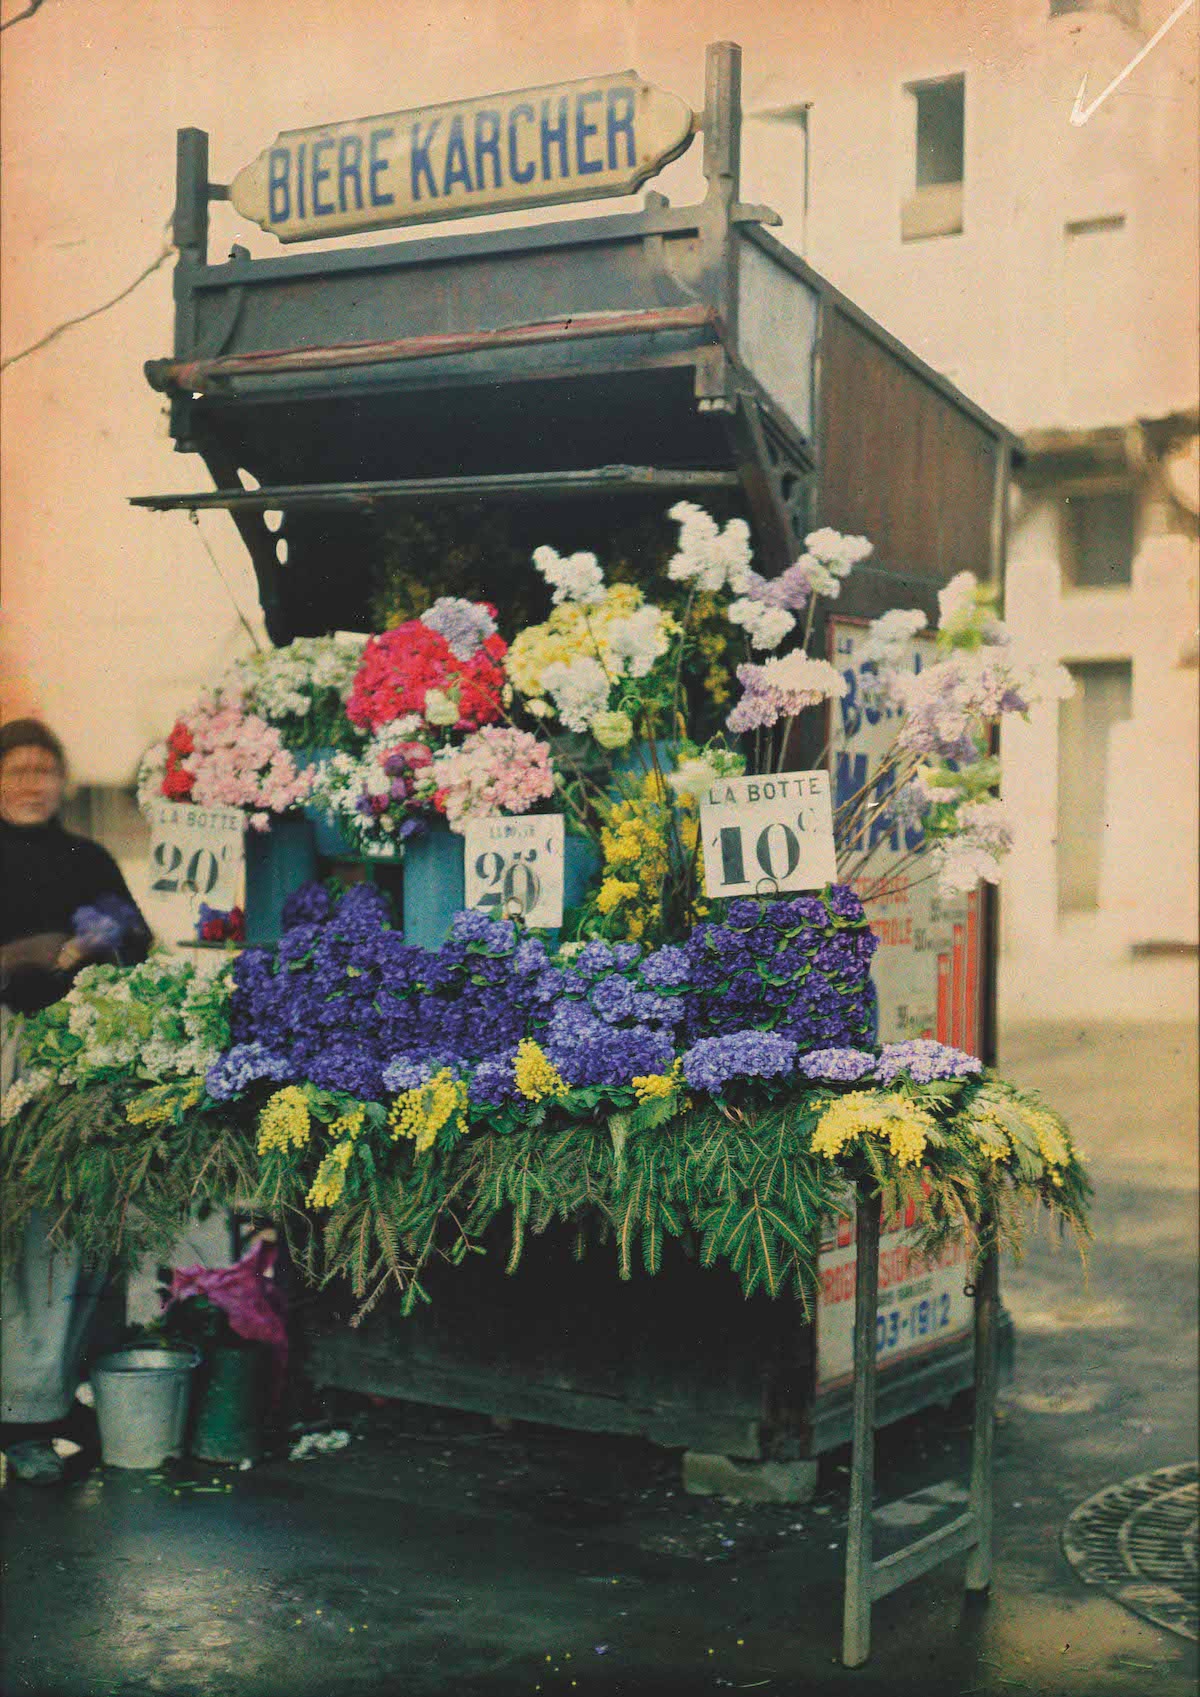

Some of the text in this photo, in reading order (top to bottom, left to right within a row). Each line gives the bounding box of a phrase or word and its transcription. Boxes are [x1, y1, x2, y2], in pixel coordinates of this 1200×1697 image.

[410, 87, 637, 200] KARCHER
[709, 778, 821, 805] LA BOTTE
